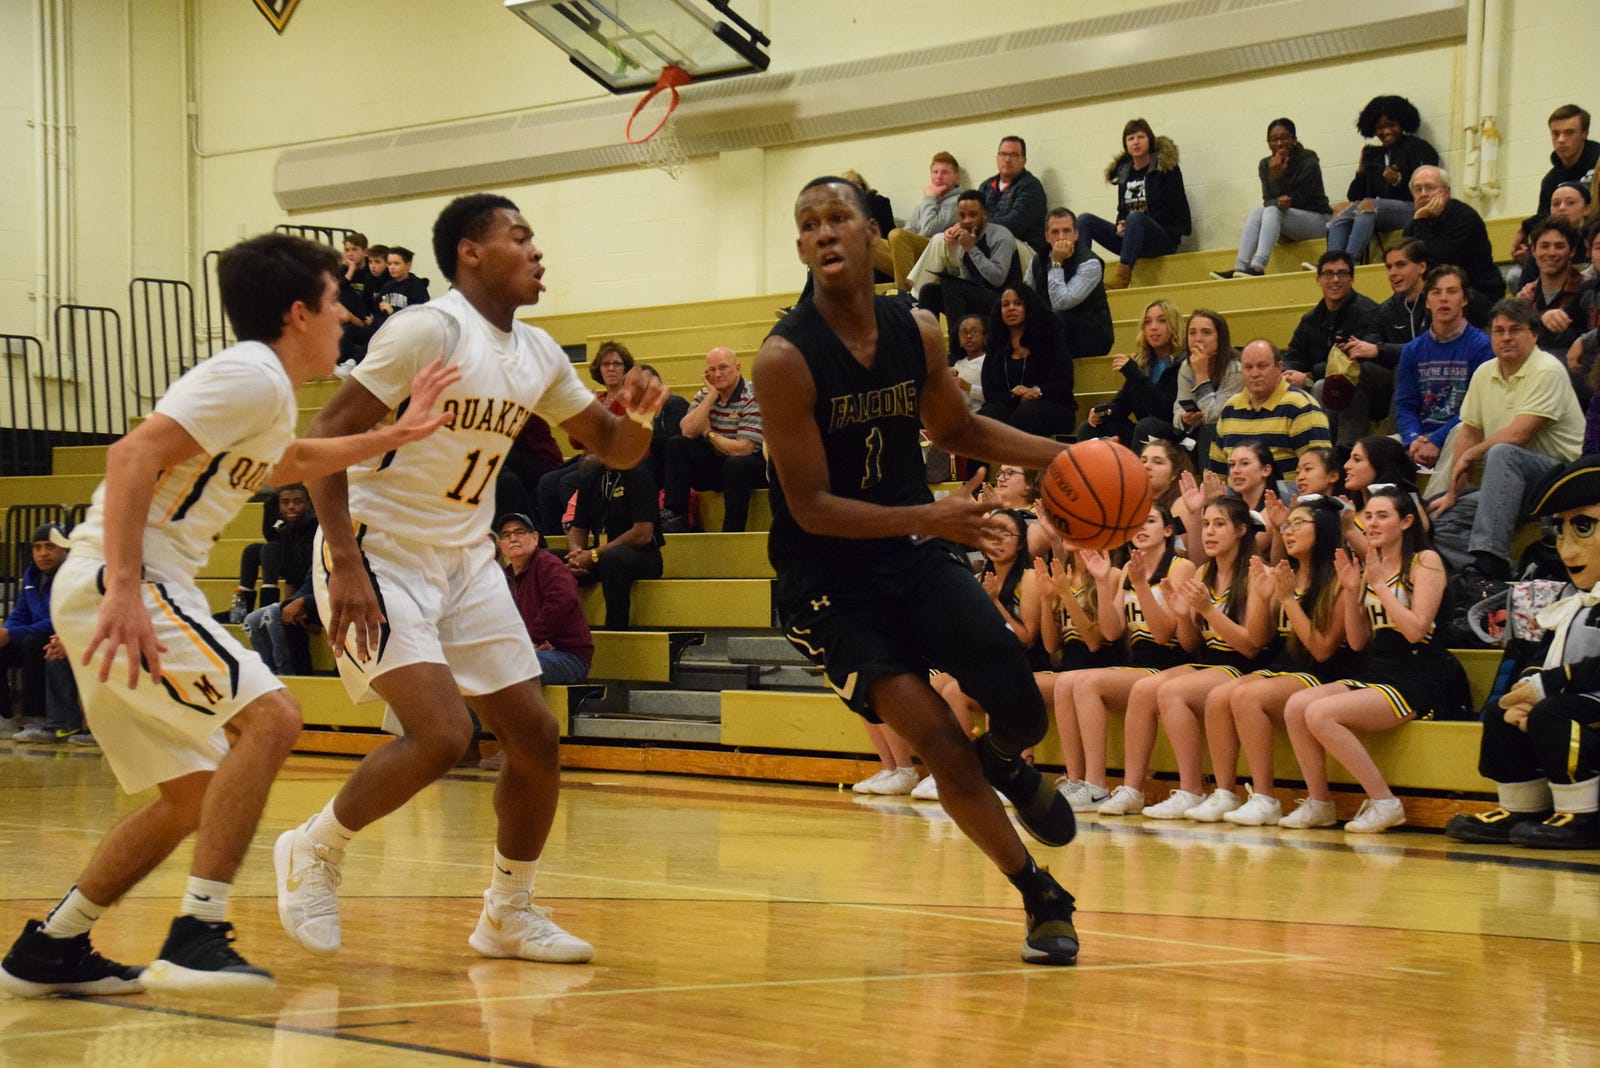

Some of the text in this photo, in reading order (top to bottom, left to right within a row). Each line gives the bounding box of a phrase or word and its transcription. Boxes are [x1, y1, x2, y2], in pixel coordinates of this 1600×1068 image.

[443, 397, 530, 439] QUAKE
[828, 379, 918, 434] FALCONS
[446, 447, 501, 506] 11
[861, 426, 883, 489] 1
